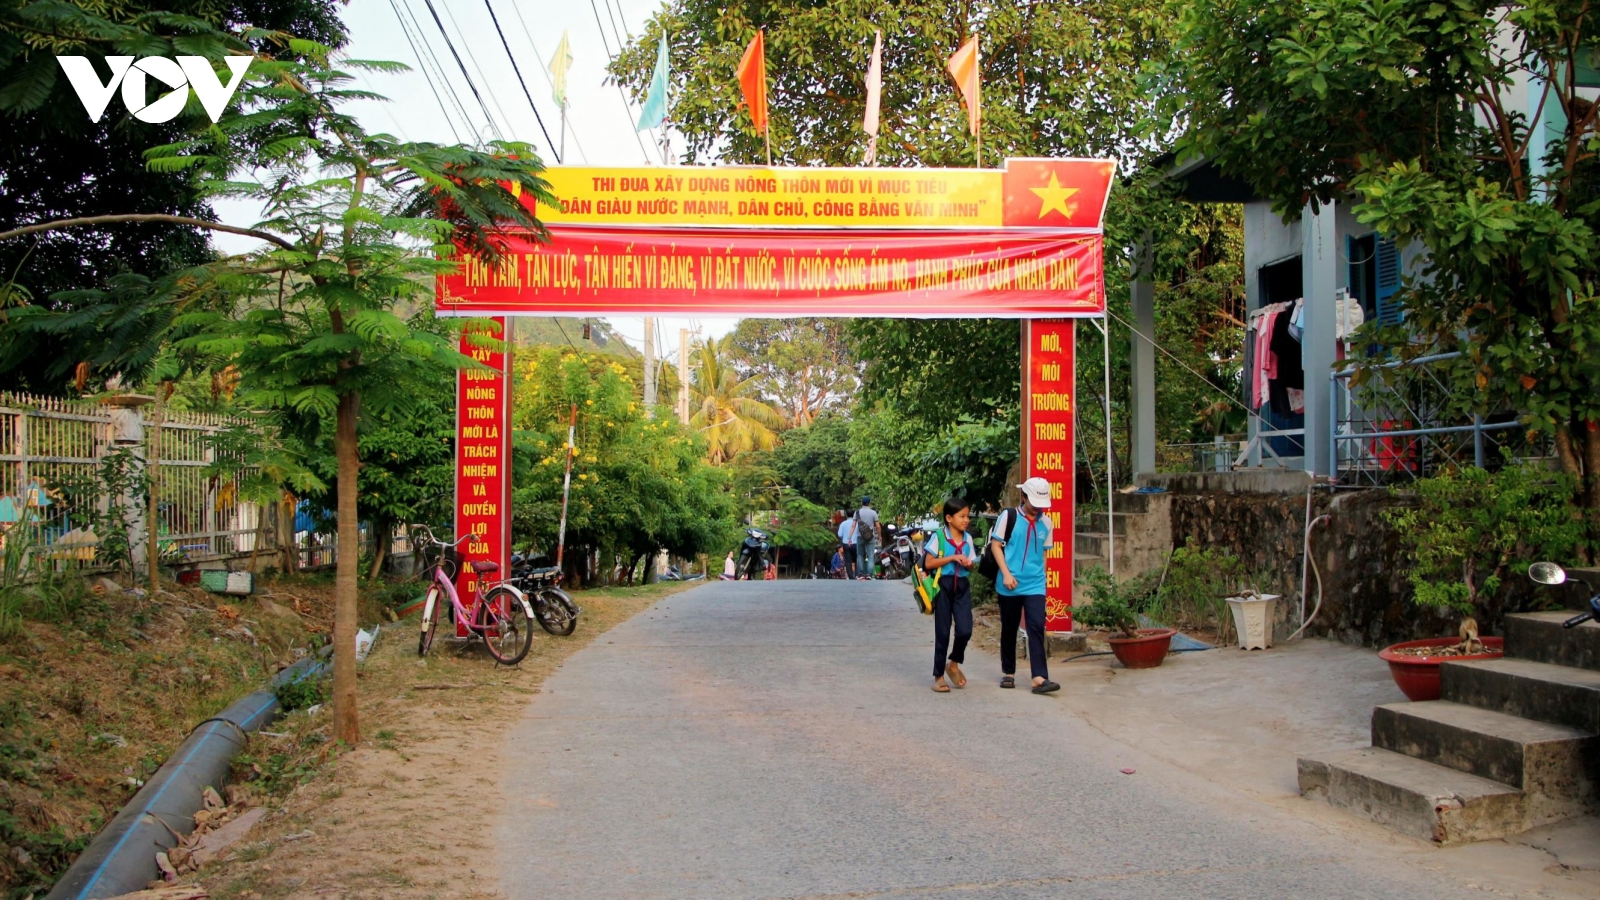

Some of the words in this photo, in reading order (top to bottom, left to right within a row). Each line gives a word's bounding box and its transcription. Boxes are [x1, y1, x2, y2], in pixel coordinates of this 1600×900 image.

[592, 177, 615, 192] THI
[620, 177, 649, 192] ĐUA
[654, 175, 683, 192] XÂY
[689, 176, 730, 195] DỰNG
[735, 175, 776, 193] NÔNG
[782, 177, 820, 194] THÔN
[825, 177, 854, 194] MỚI
[859, 177, 872, 194] VÌ
[878, 179, 911, 197] MỤC
[916, 177, 947, 195] TIÊU
[596, 197, 631, 215] GIÀU
[637, 197, 678, 215] NƯỚC
[683, 200, 733, 218] MẠNH,
[738, 198, 769, 216] DÂN
[774, 197, 808, 218] CHỦ,
[813, 199, 854, 217] CÔNG
[859, 196, 899, 217] BẰNG
[904, 199, 934, 217] VĂN
[525, 245, 550, 295] TẬN
[553, 248, 580, 295] LỰC,
[584, 245, 608, 295] TẬN
[612, 241, 641, 289] HIẾN
[645, 246, 657, 289] VÌ
[660, 242, 697, 296] ĐẢNG,
[700, 247, 712, 290] VÌ
[716, 243, 740, 290] ĐẤT
[744, 247, 779, 297] NƯỚC,
[783, 247, 795, 290] VÌ
[799, 248, 831, 298] CUỘC
[834, 244, 866, 291] SỐNG
[870, 244, 888, 291] ẤM
[892, 257, 912, 298] NO,
[915, 258, 948, 298] HẠNH
[952, 250, 983, 291] PHÚC
[987, 246, 1011, 291] CỦA
[1014, 249, 1046, 291] NHÂN
[1050, 249, 1079, 291] DÂN!
[1041, 331, 1062, 354] MỚI,
[471, 347, 492, 361] XÂY
[1041, 360, 1060, 381] MÔI
[466, 386, 496, 400] NÔNG
[1032, 389, 1069, 411] TRƯỜNG
[467, 405, 494, 419] THÔN
[462, 424, 483, 438] MỚI
[486, 423, 498, 438] LÀ
[1035, 423, 1066, 440] TRONG
[463, 443, 497, 457] TRÁCH
[463, 462, 497, 479] NHIỆM
[1036, 452, 1064, 474] SẠCH,
[473, 482, 486, 496] VÀ
[1049, 482, 1062, 500] NG
[471, 522, 487, 537] LỢI
[468, 538, 490, 554] CỦA
[1046, 541, 1063, 559] NH
[1046, 567, 1060, 588] ÊN
